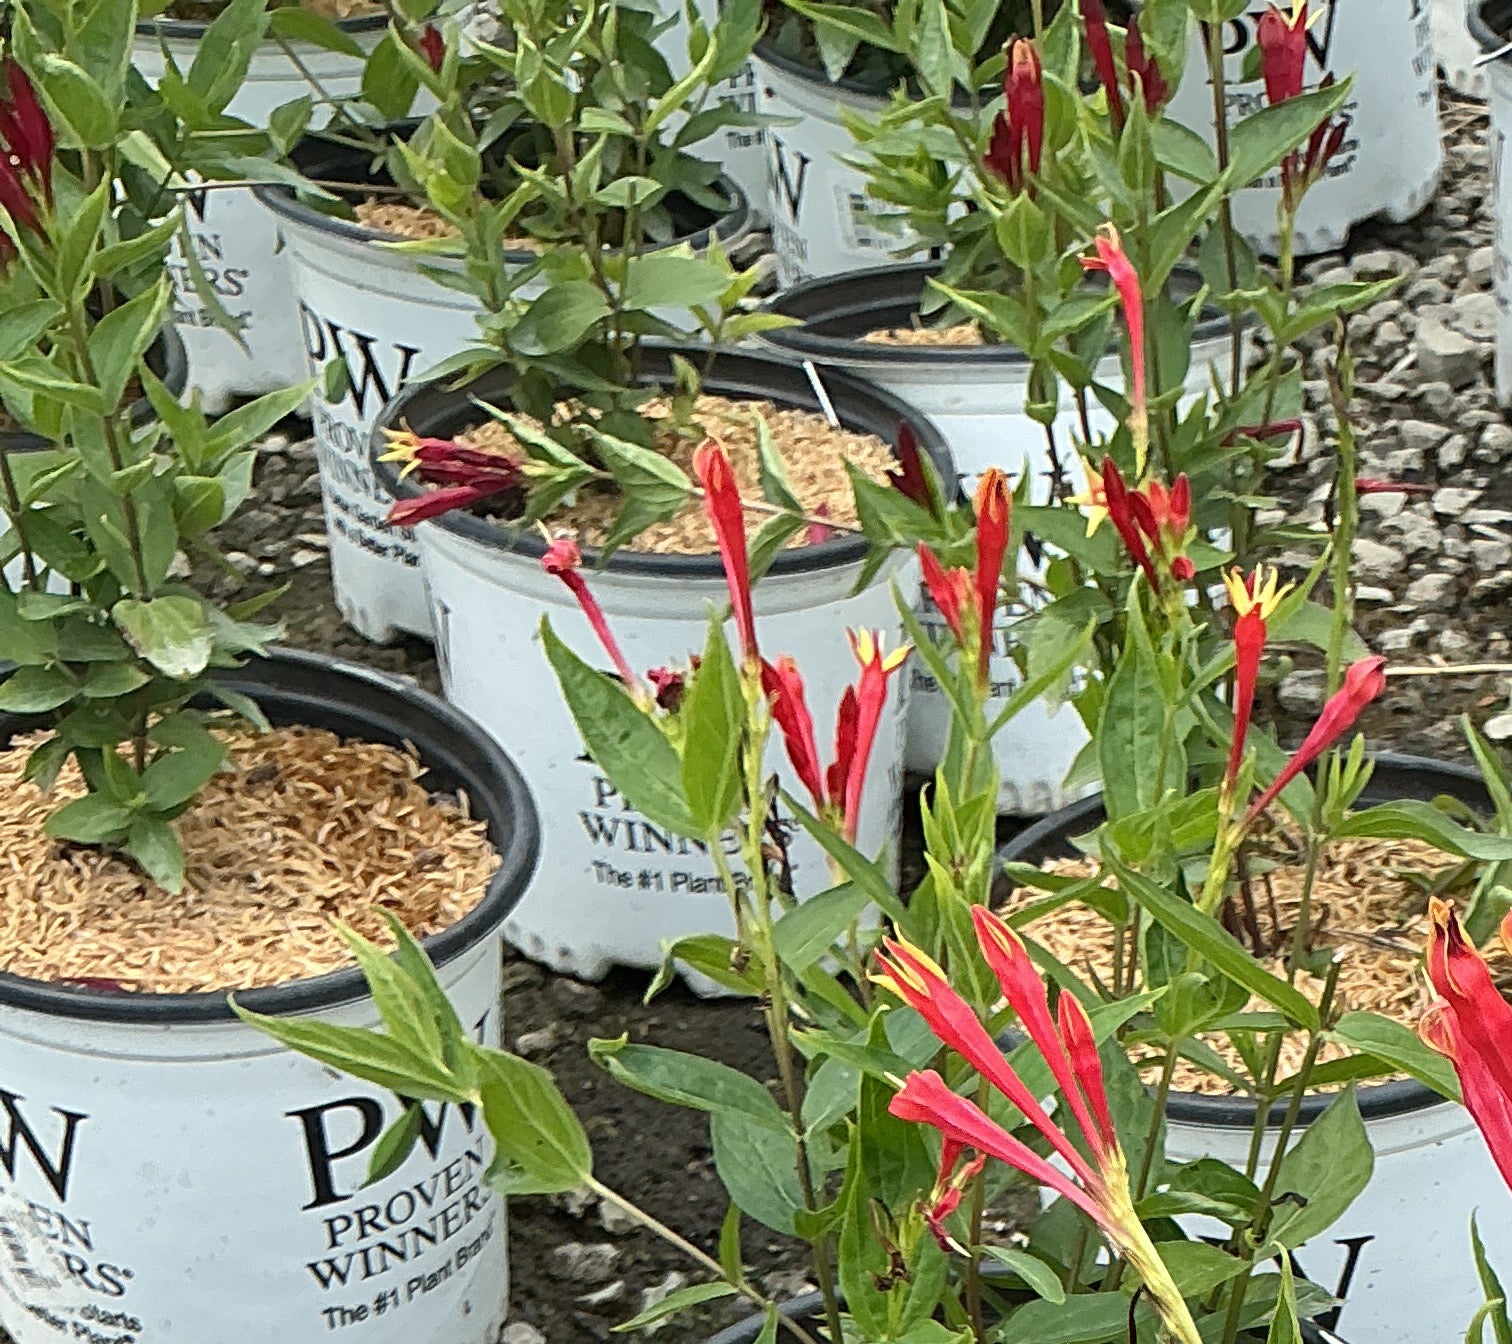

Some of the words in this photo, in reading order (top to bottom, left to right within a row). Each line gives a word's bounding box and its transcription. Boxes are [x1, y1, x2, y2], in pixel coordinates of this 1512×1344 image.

[0, 1085, 90, 1203] W
[323, 1135, 486, 1249] PROVEN
[305, 1185, 492, 1291] WINNER
[321, 1304, 369, 1331] The
[372, 1287, 402, 1316] #1
[404, 1257, 453, 1303] Plant
